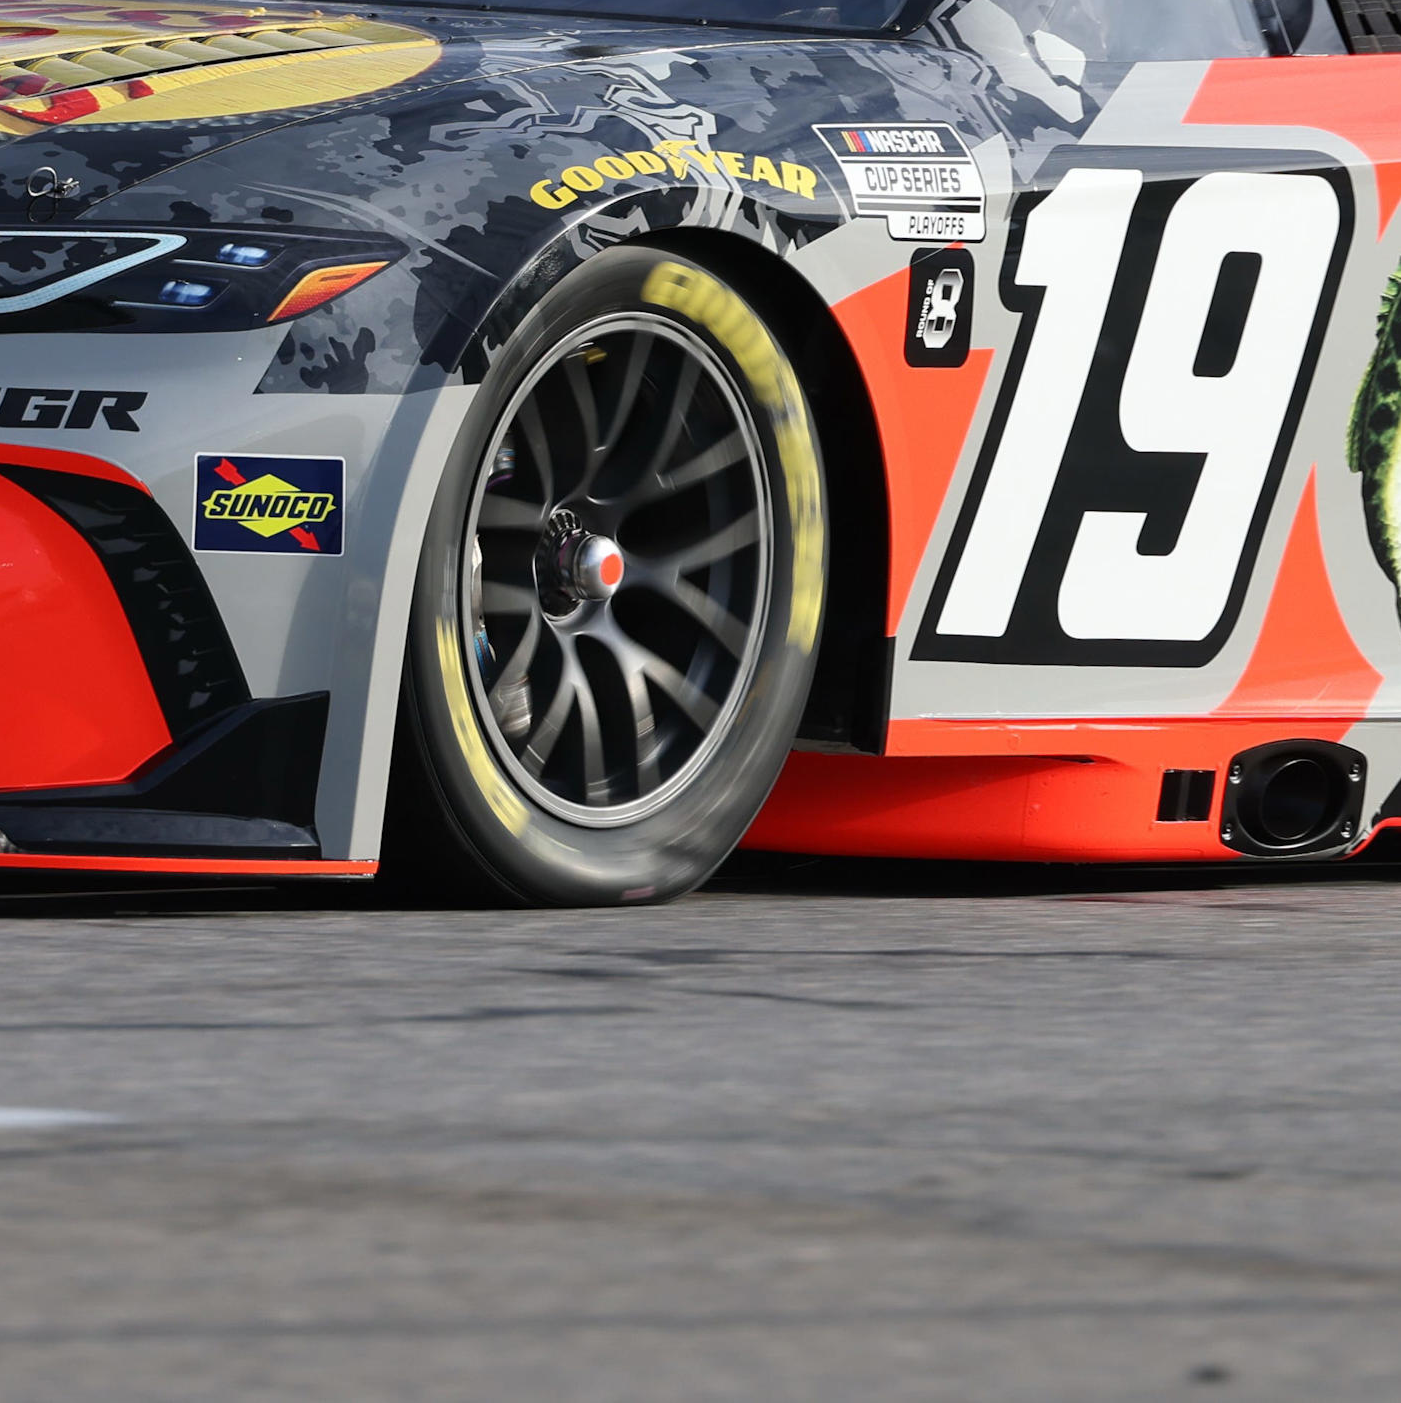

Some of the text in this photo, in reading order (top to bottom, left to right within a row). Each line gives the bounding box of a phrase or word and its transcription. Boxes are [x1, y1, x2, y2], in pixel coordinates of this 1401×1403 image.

[865, 130, 946, 153] NASCAR
[865, 166, 962, 193] CUP SERIES
[908, 215, 965, 235] PLAYOFFS
[916, 298, 930, 338] ROUND
[922, 268, 965, 349] 8
[935, 167, 1341, 642] 19
[209, 492, 331, 521] SUNOCO
